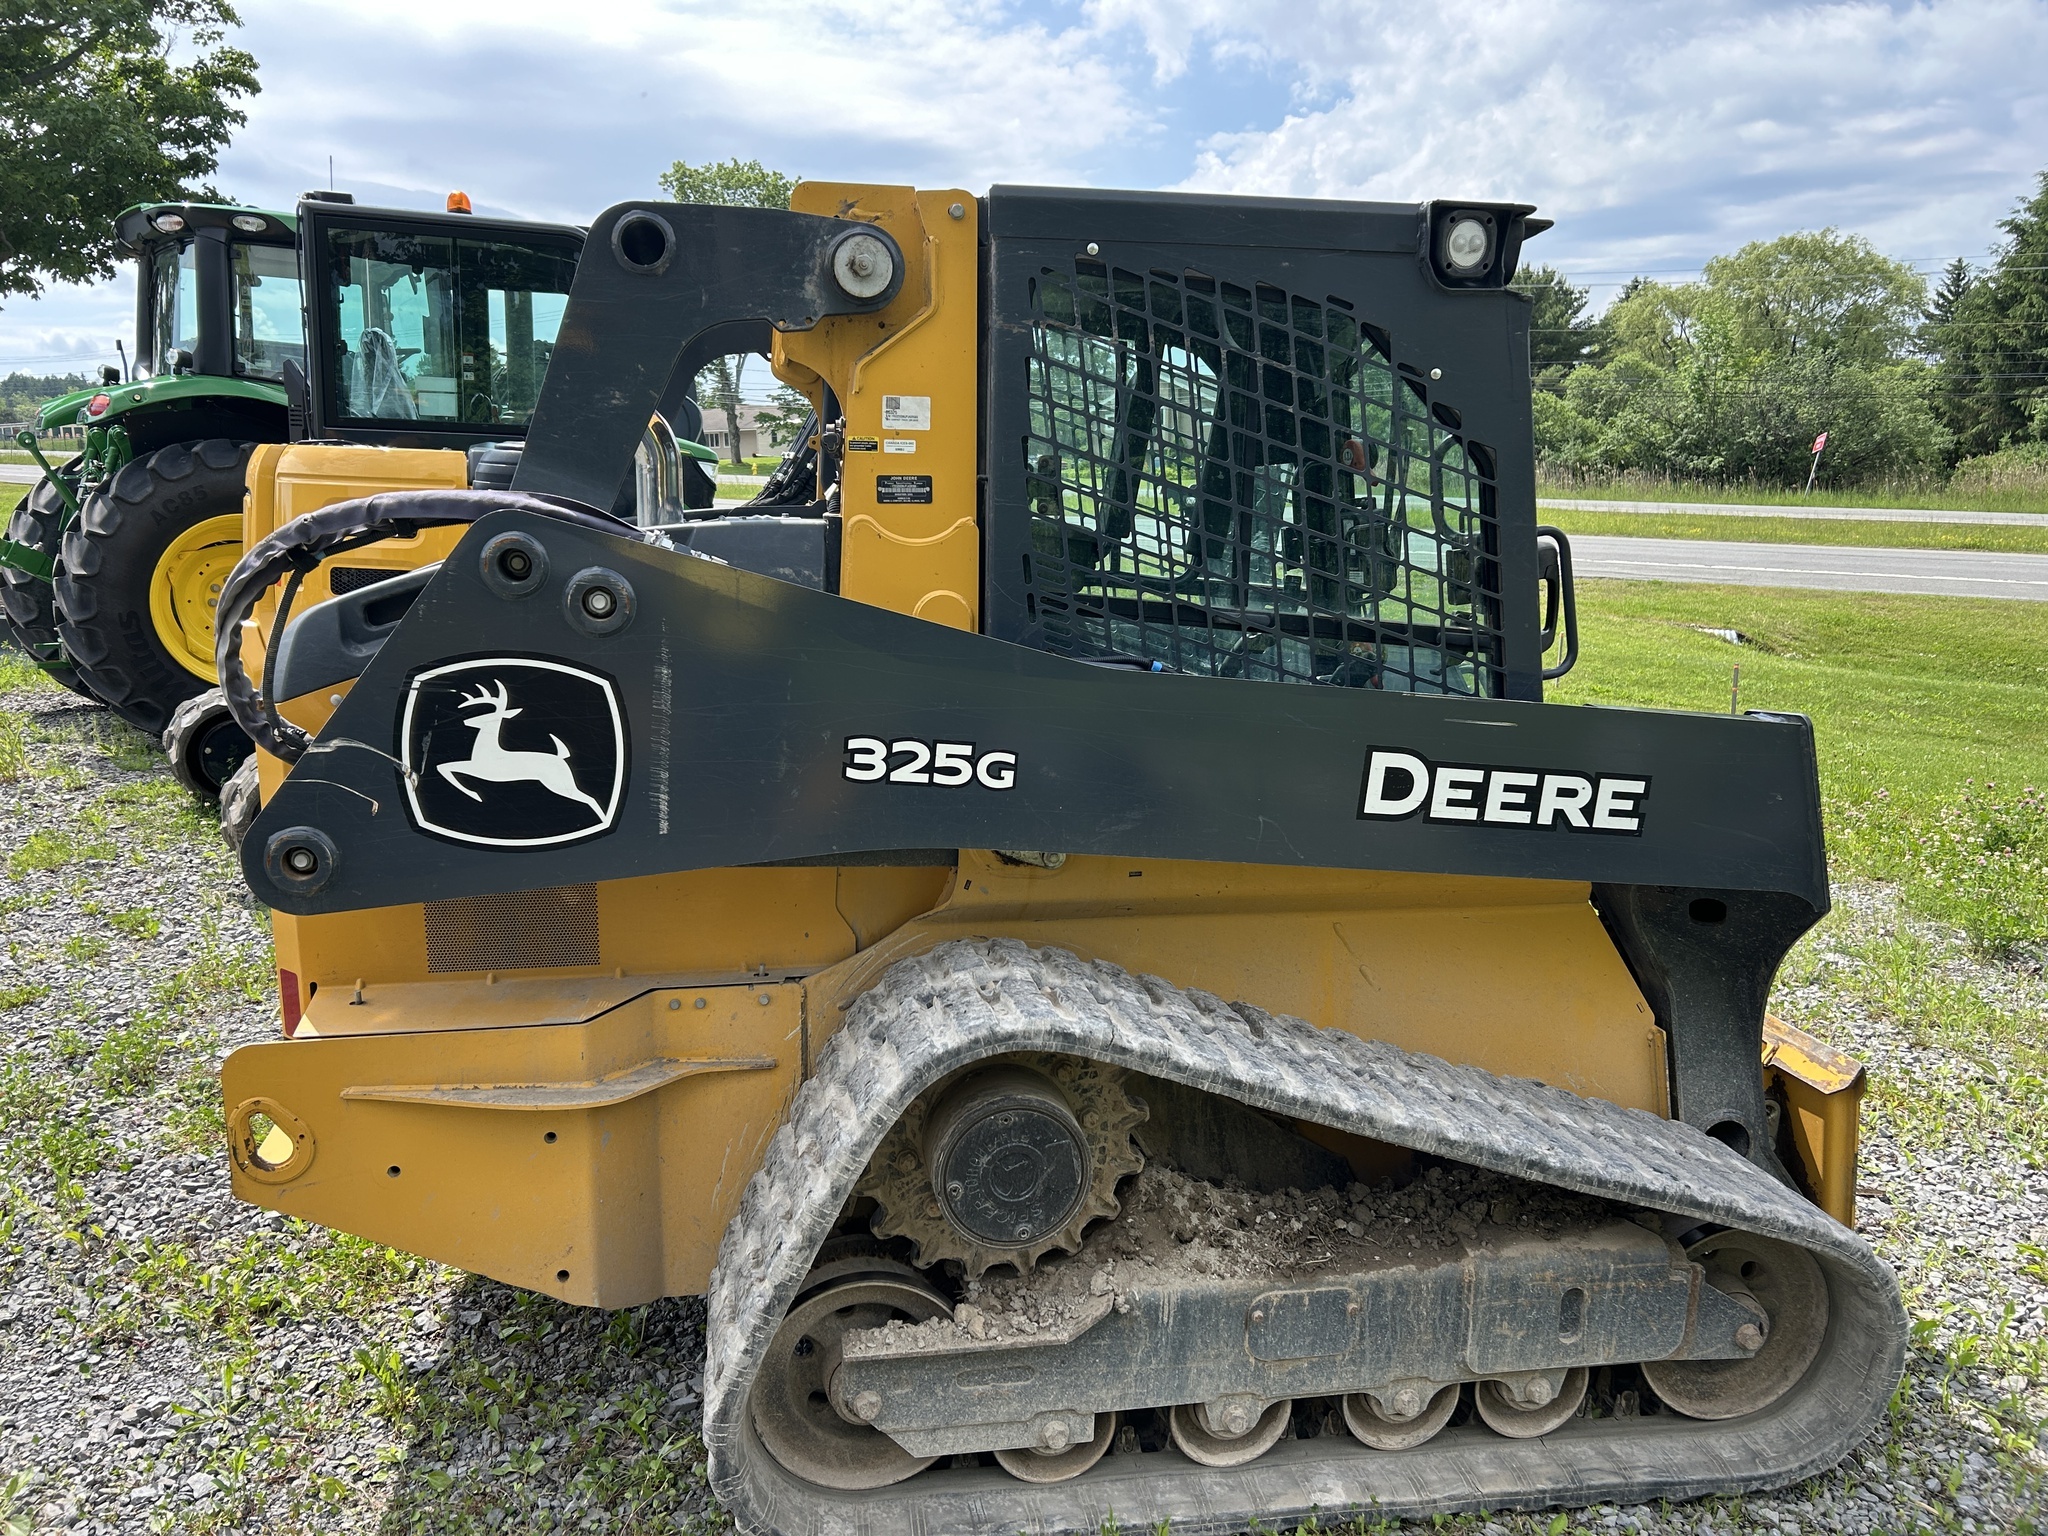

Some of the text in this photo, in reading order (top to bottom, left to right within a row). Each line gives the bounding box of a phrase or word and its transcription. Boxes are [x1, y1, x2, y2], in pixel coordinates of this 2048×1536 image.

[149, 484, 209, 527] AC85
[845, 738, 1016, 789] 325G
[1363, 751, 1646, 831] DEERE
